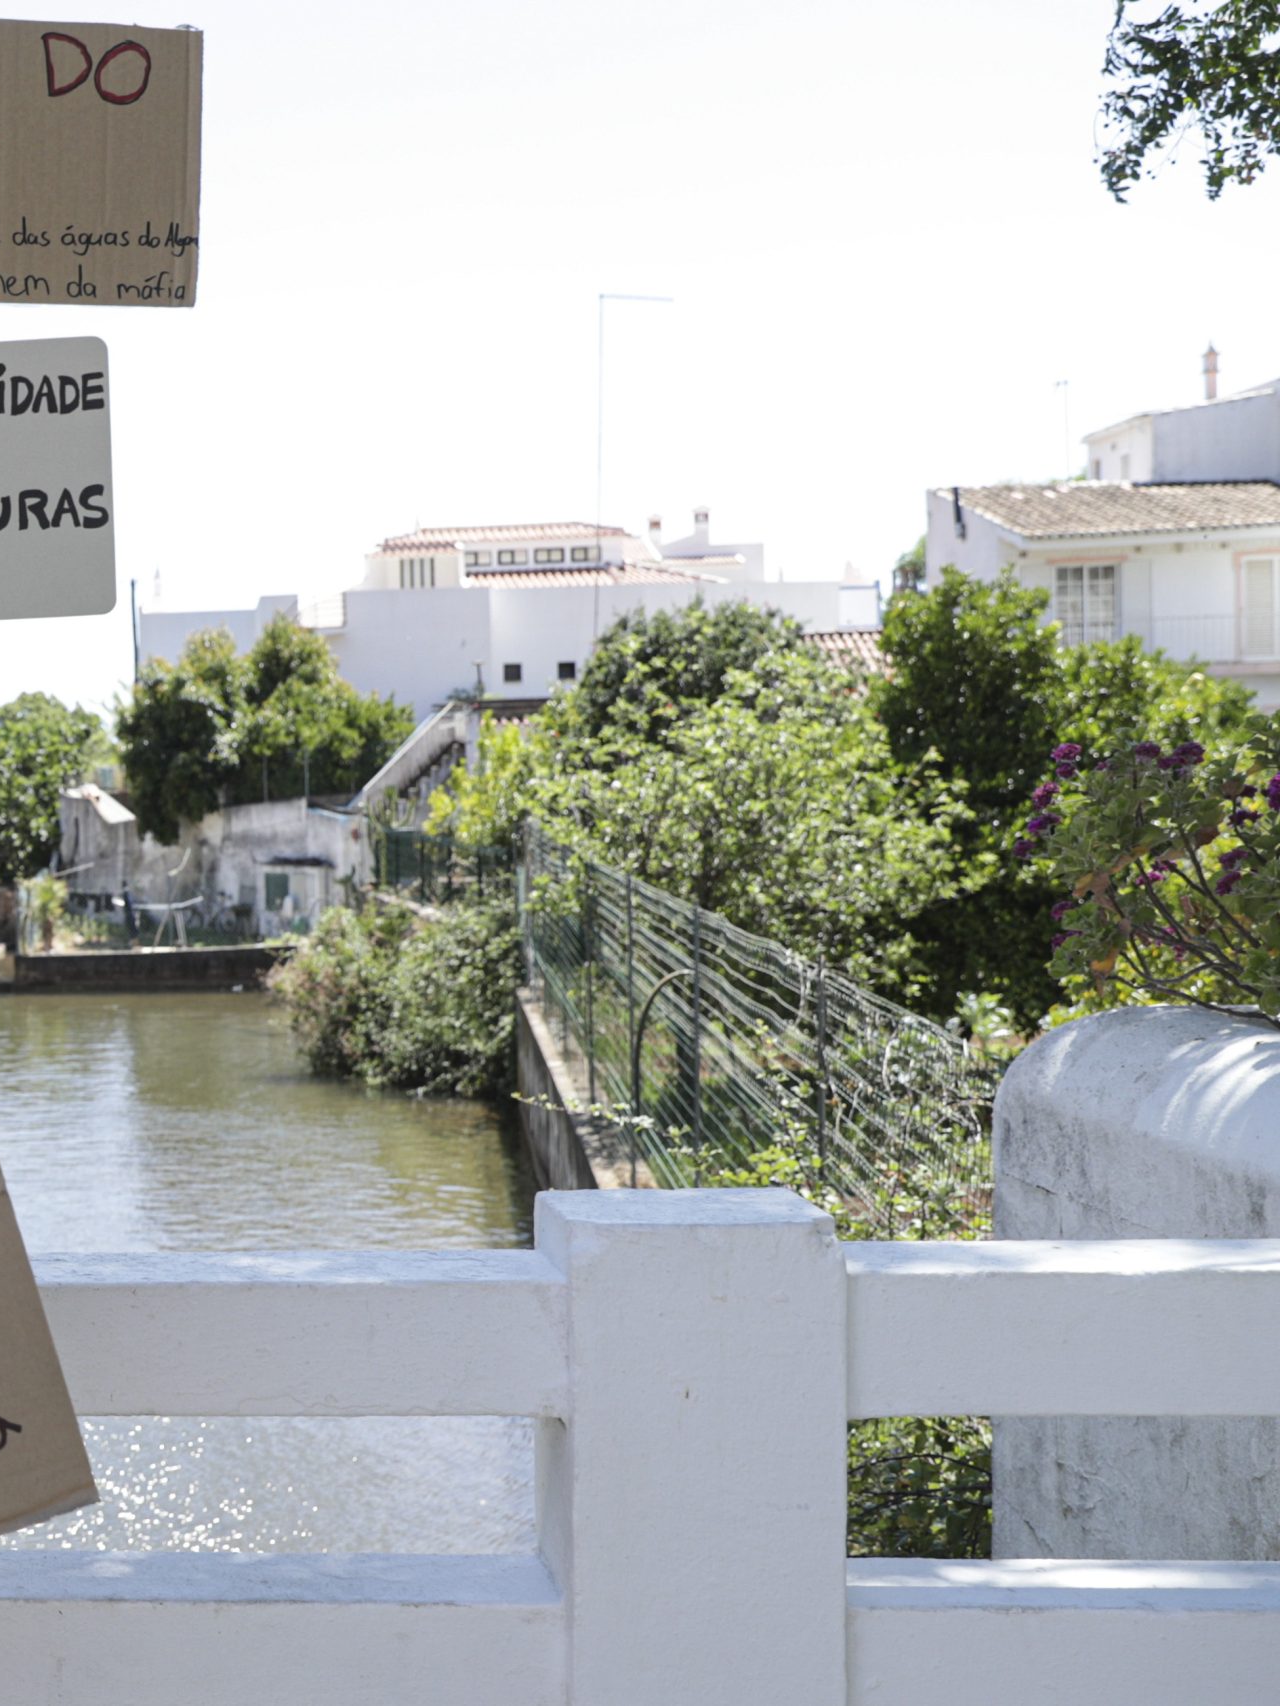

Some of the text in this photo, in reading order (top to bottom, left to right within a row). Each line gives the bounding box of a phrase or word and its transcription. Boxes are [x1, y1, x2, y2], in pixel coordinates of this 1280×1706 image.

[41, 32, 152, 104] DO
[12, 216, 51, 247] das
[60, 225, 130, 256] águas
[138, 221, 160, 248] do
[66, 264, 98, 299] da
[117, 270, 186, 301] máfia
